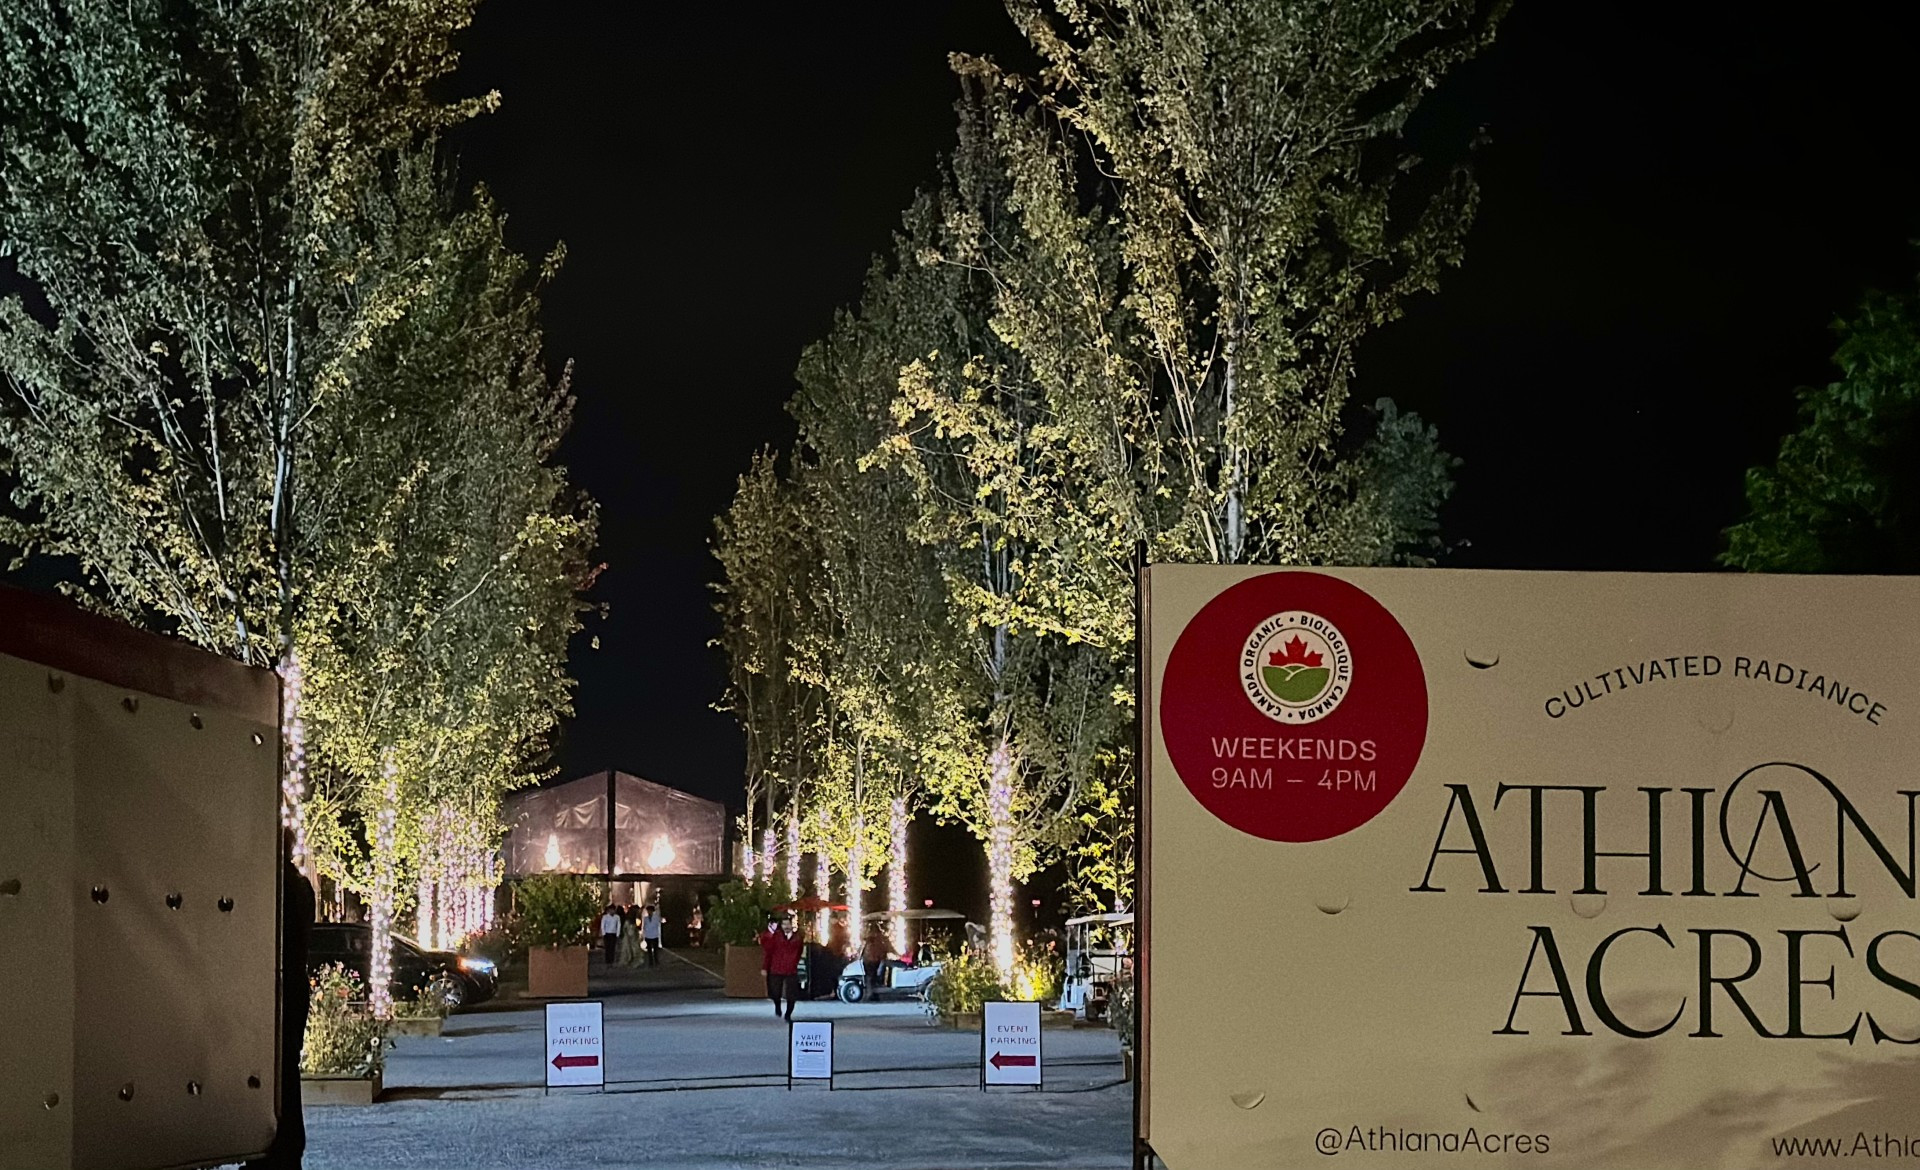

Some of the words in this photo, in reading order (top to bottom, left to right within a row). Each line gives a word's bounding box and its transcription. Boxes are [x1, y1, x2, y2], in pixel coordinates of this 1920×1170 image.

[1244, 617, 1284, 667] ORGANIC
[1300, 615, 1349, 682] BIOLOGIQUE
[1245, 672, 1282, 717] CANADA
[1298, 685, 1344, 720] CANADA
[1544, 655, 1722, 719] CULTIVATED
[1734, 656, 1888, 726] RADIANCE
[1211, 736, 1377, 762] WEEKENDS
[1211, 767, 1273, 790] 9AM
[1317, 768, 1377, 792] 4PM
[1492, 923, 1920, 1046] ACRES
[552, 1037, 599, 1046] PARKING
[559, 1025, 591, 1034] EVENT
[990, 1037, 1037, 1045] PARKING
[997, 1025, 1029, 1033] EVENT
[795, 1040, 827, 1048] PARKING
[1315, 1125, 1550, 1156] @AthianaAcres
